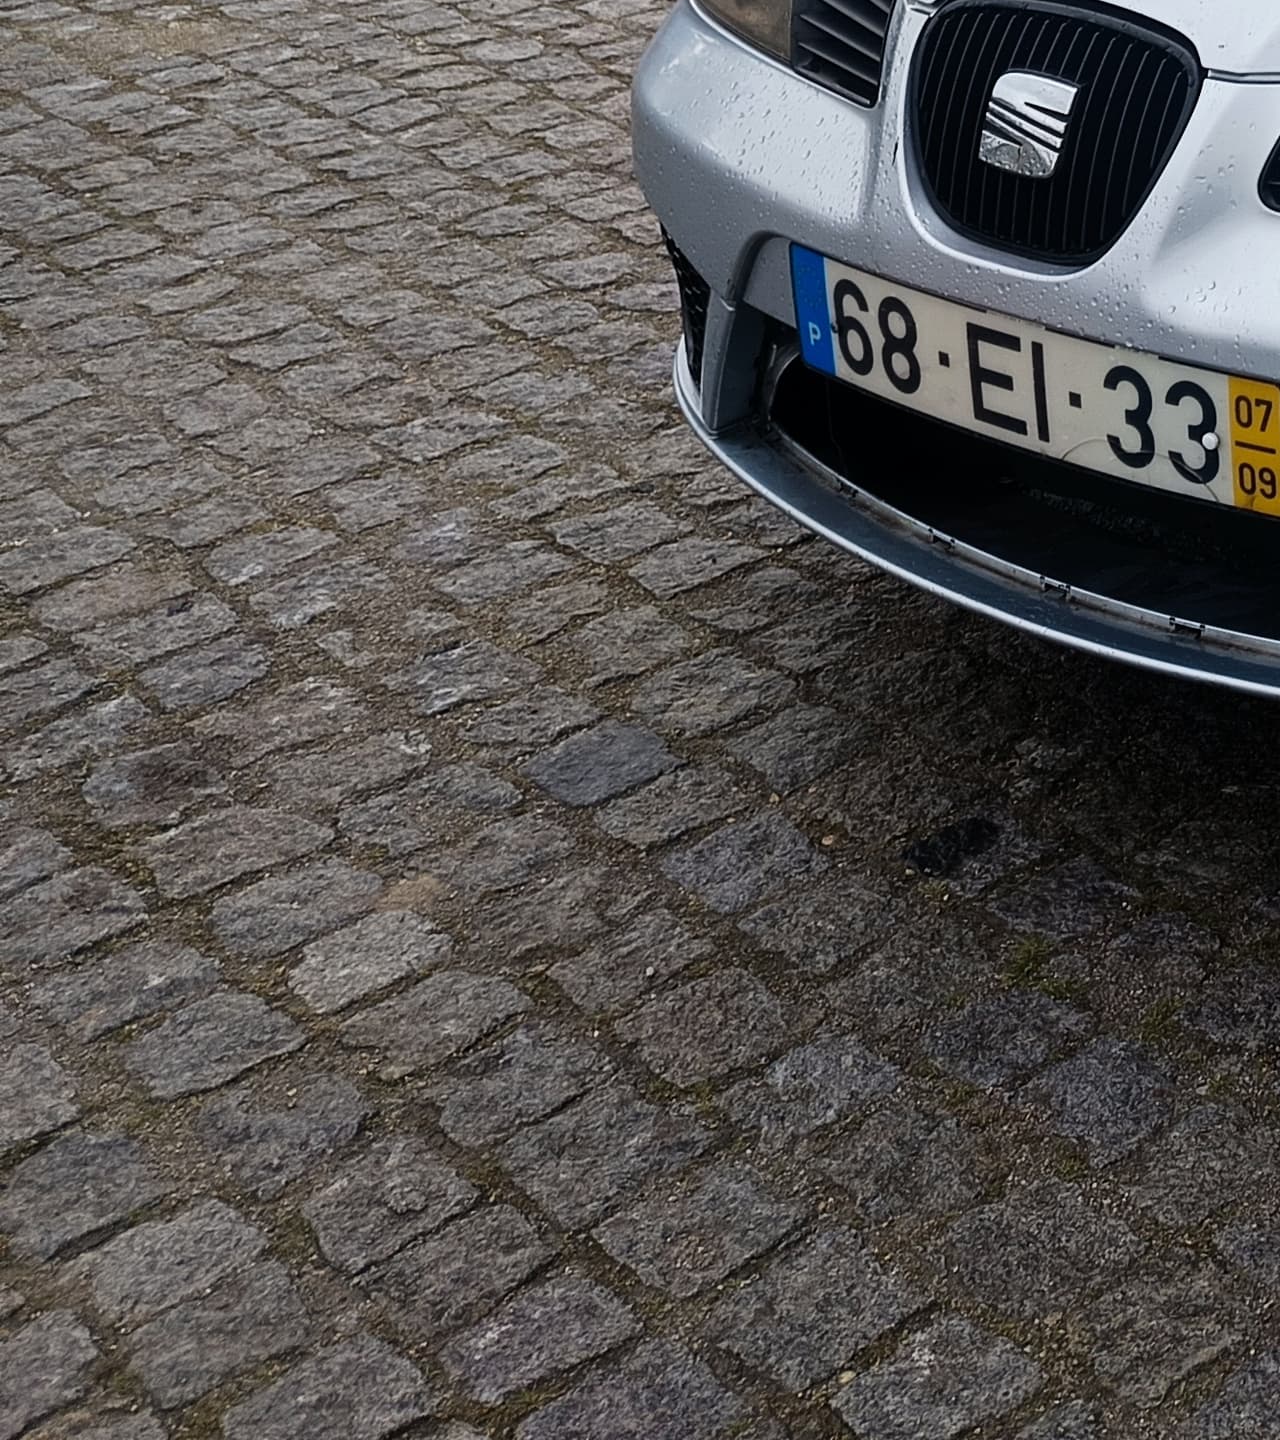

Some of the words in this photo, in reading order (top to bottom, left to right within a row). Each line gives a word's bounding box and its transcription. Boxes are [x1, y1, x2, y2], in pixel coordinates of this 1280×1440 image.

[808, 321, 822, 345] P
[1234, 395, 1273, 432] 07
[1238, 462, 1277, 500] 09
